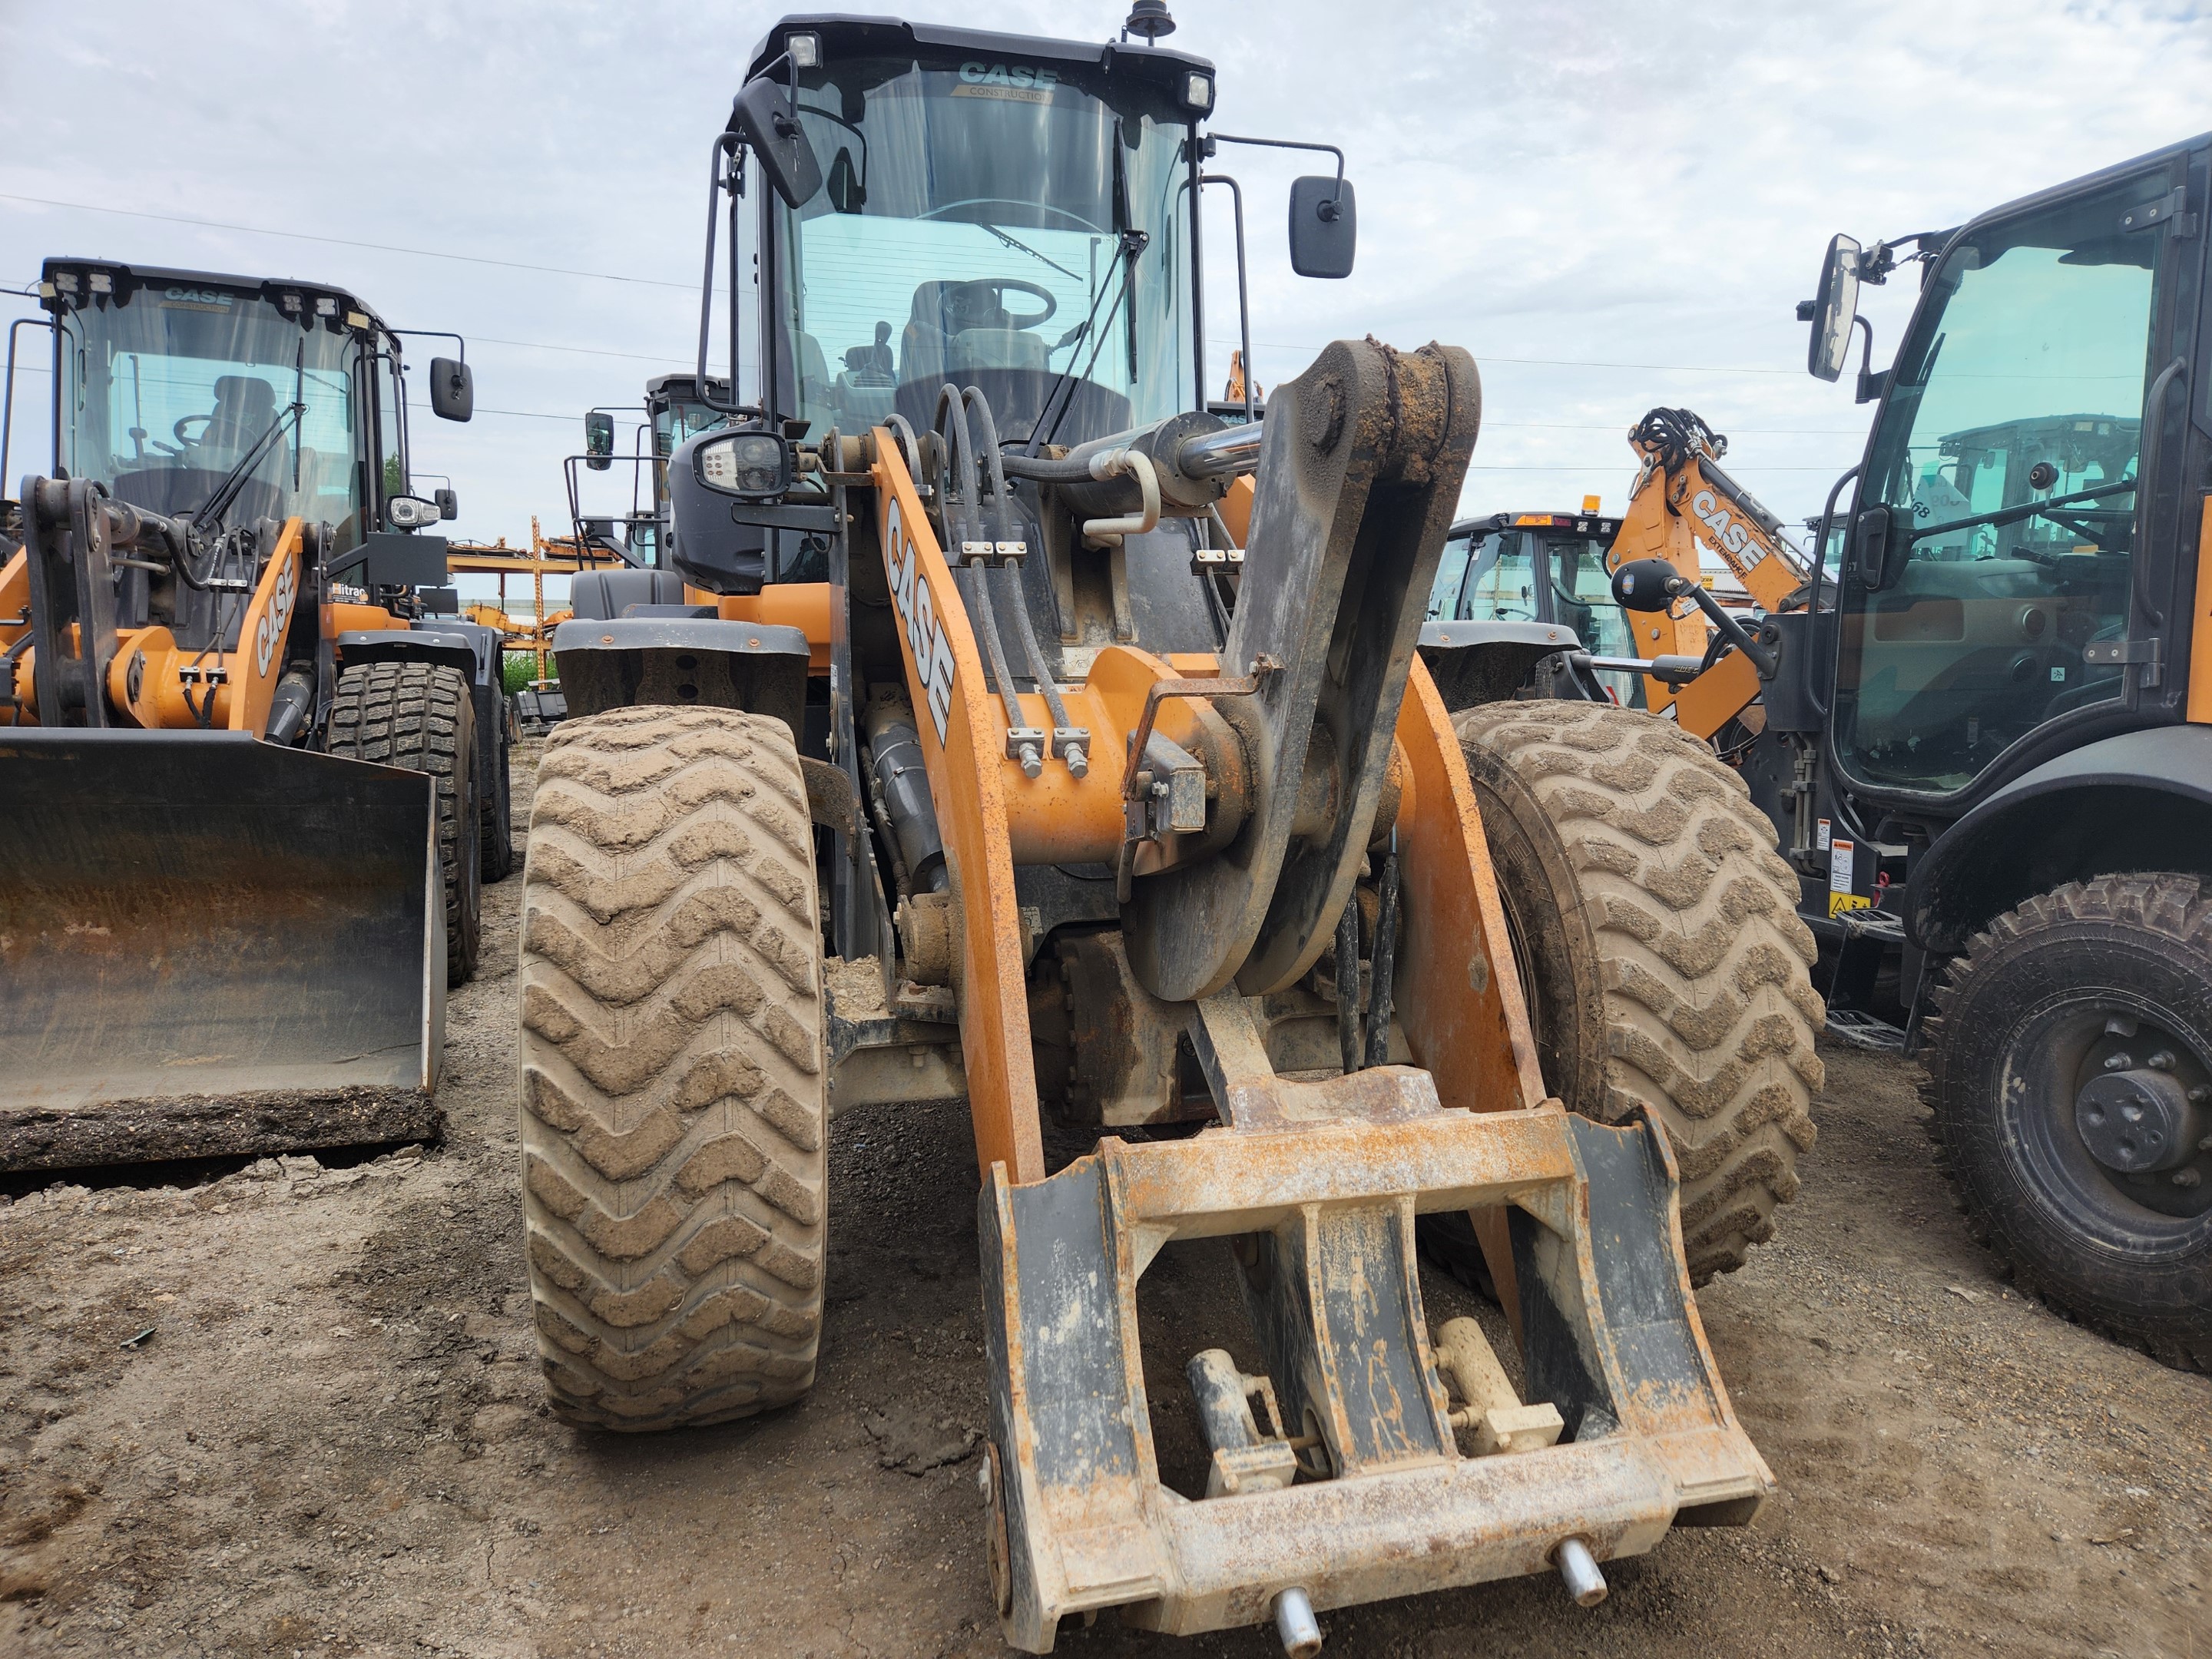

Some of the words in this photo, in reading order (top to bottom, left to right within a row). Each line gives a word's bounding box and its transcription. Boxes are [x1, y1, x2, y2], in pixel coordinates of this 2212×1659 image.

[959, 61, 1058, 91] CASE
[969, 87, 1051, 102] CONSTRUCTION
[164, 287, 234, 306] CASE
[171, 302, 228, 312] CONSTRUCTION
[1218, 414, 1247, 424] CAS
[1692, 490, 1769, 572] CASE
[1708, 535, 1747, 579] EXTENDAHOE
[257, 549, 295, 677] CASE
[886, 495, 955, 752] CASE
